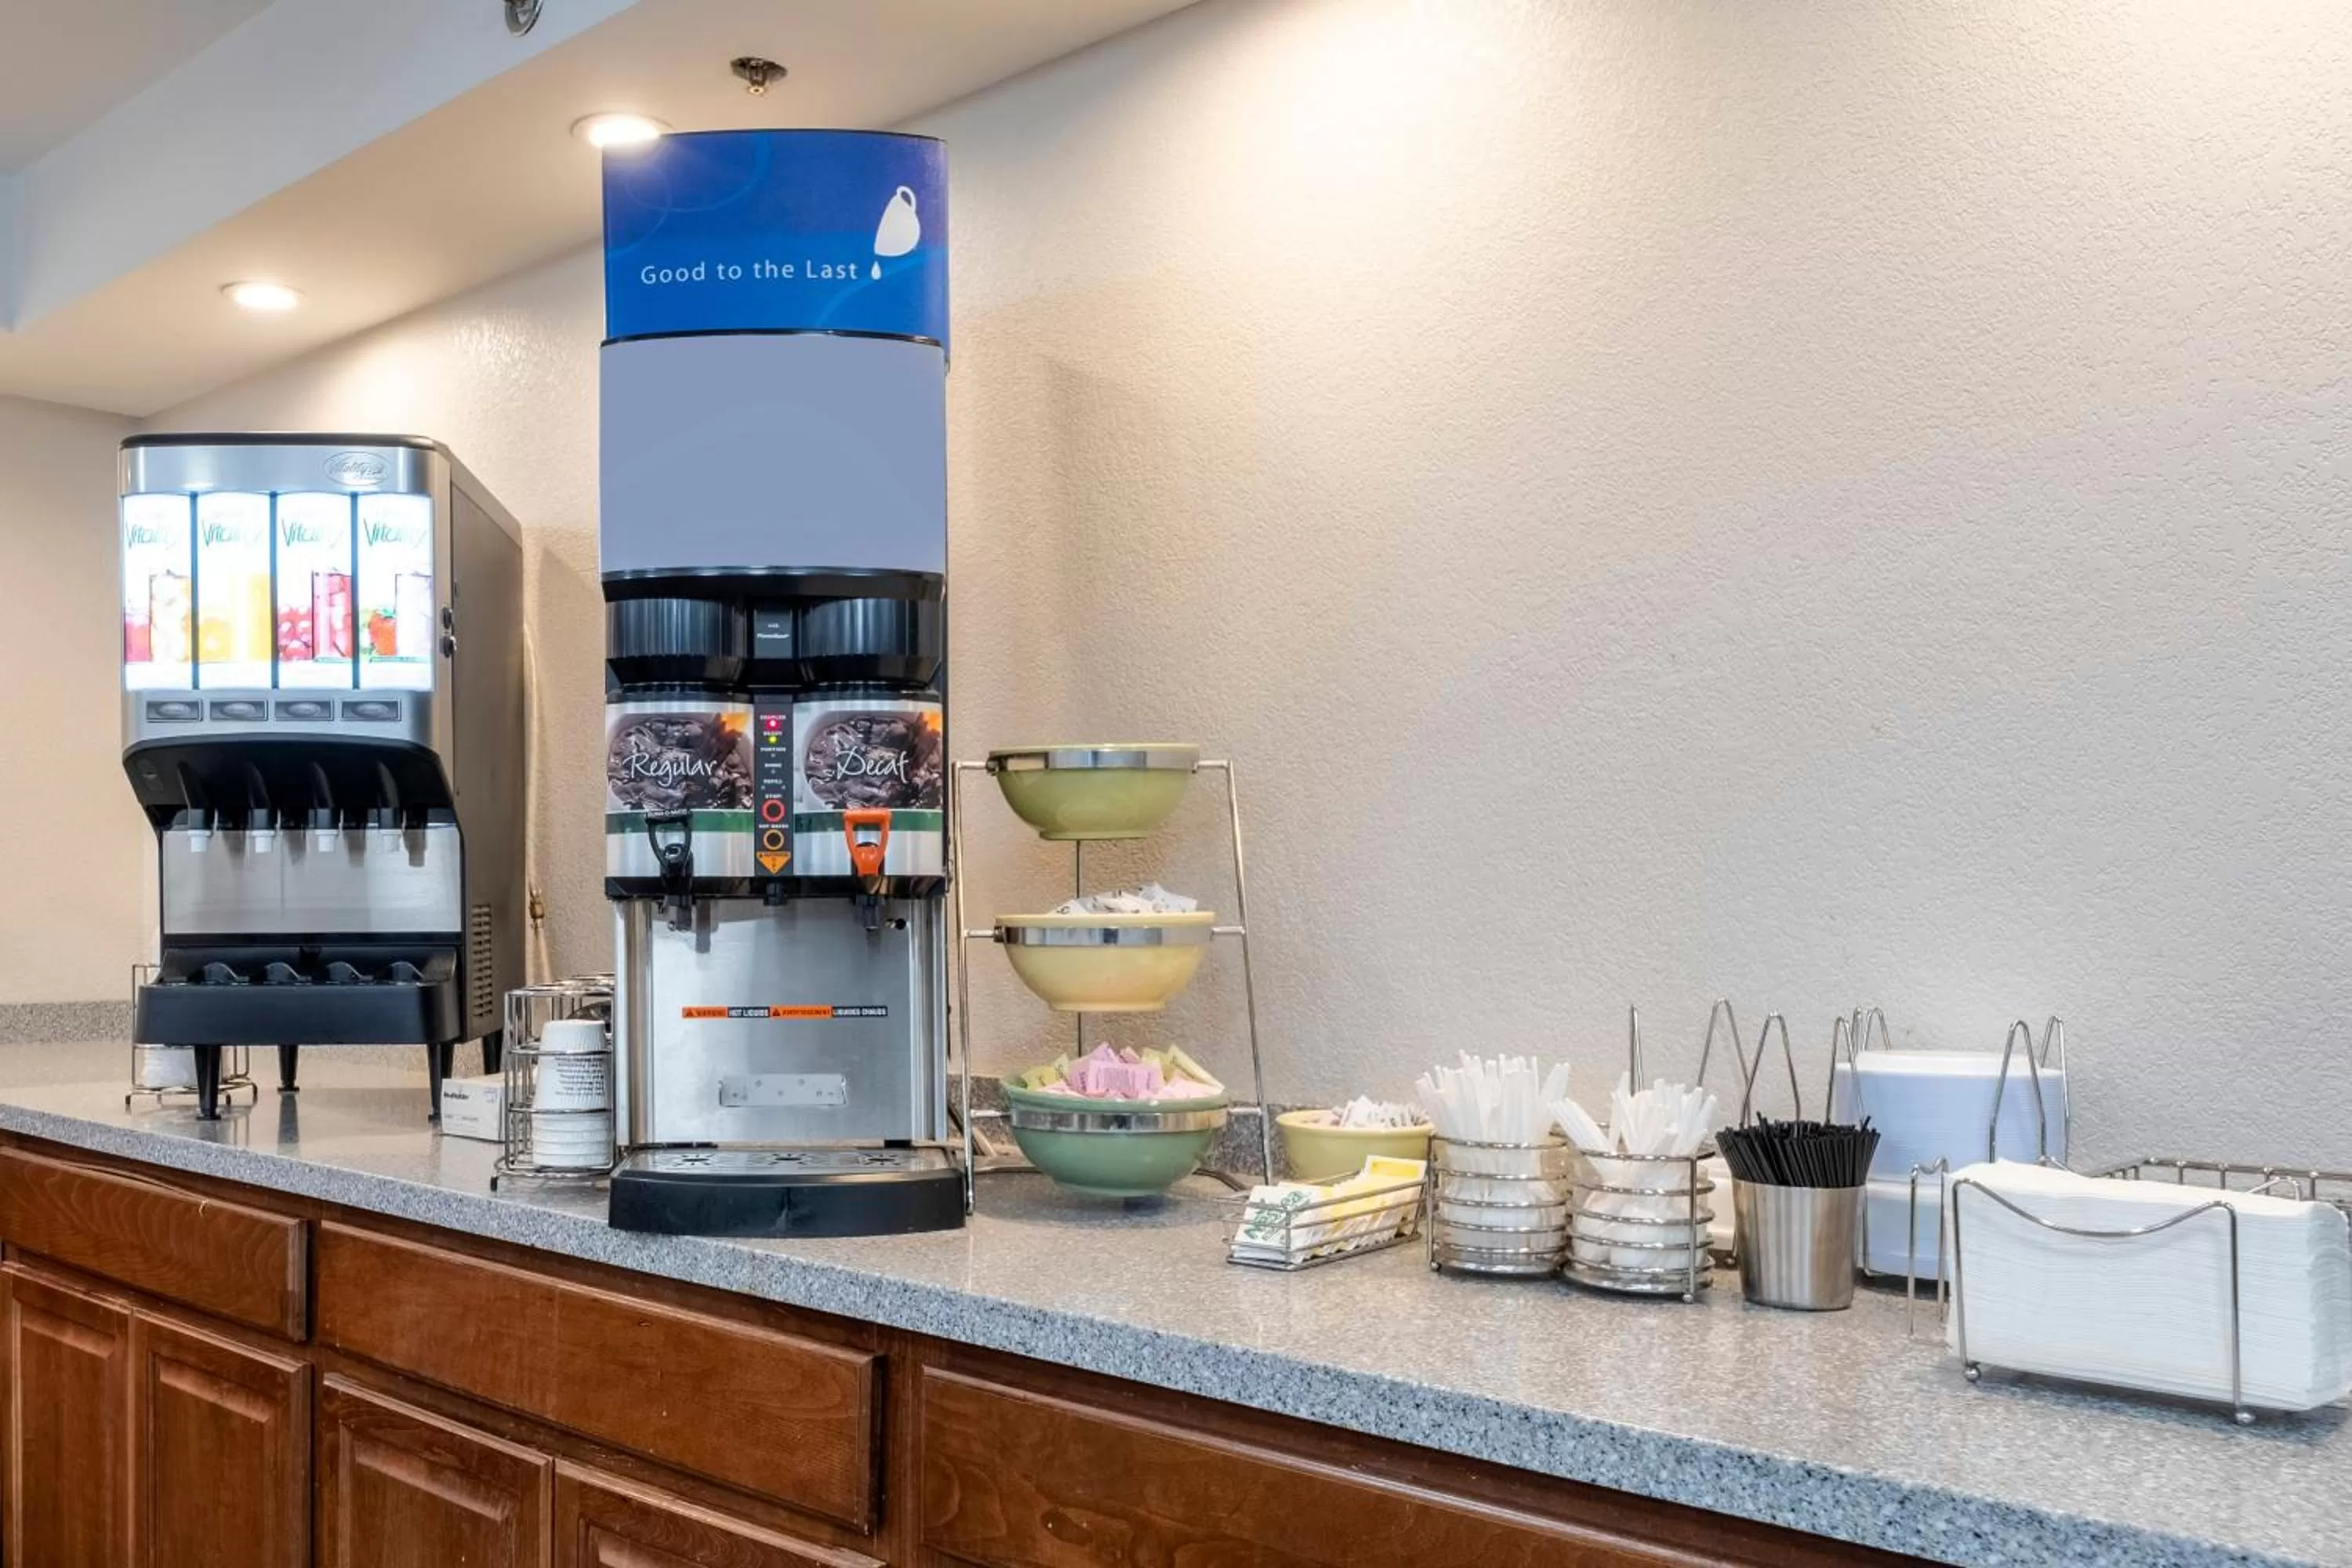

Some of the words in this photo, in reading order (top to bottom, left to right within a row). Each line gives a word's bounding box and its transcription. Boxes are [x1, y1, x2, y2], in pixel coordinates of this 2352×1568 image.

[641, 261, 706, 285] Good
[716, 263, 742, 280] to
[753, 259, 794, 279] the
[806, 260, 858, 280] Last
[201, 517, 264, 548] Vitay
[281, 517, 343, 548] Vitay
[363, 517, 428, 548] Vitay
[622, 752, 717, 787] Regular
[836, 746, 909, 783] Decaf
